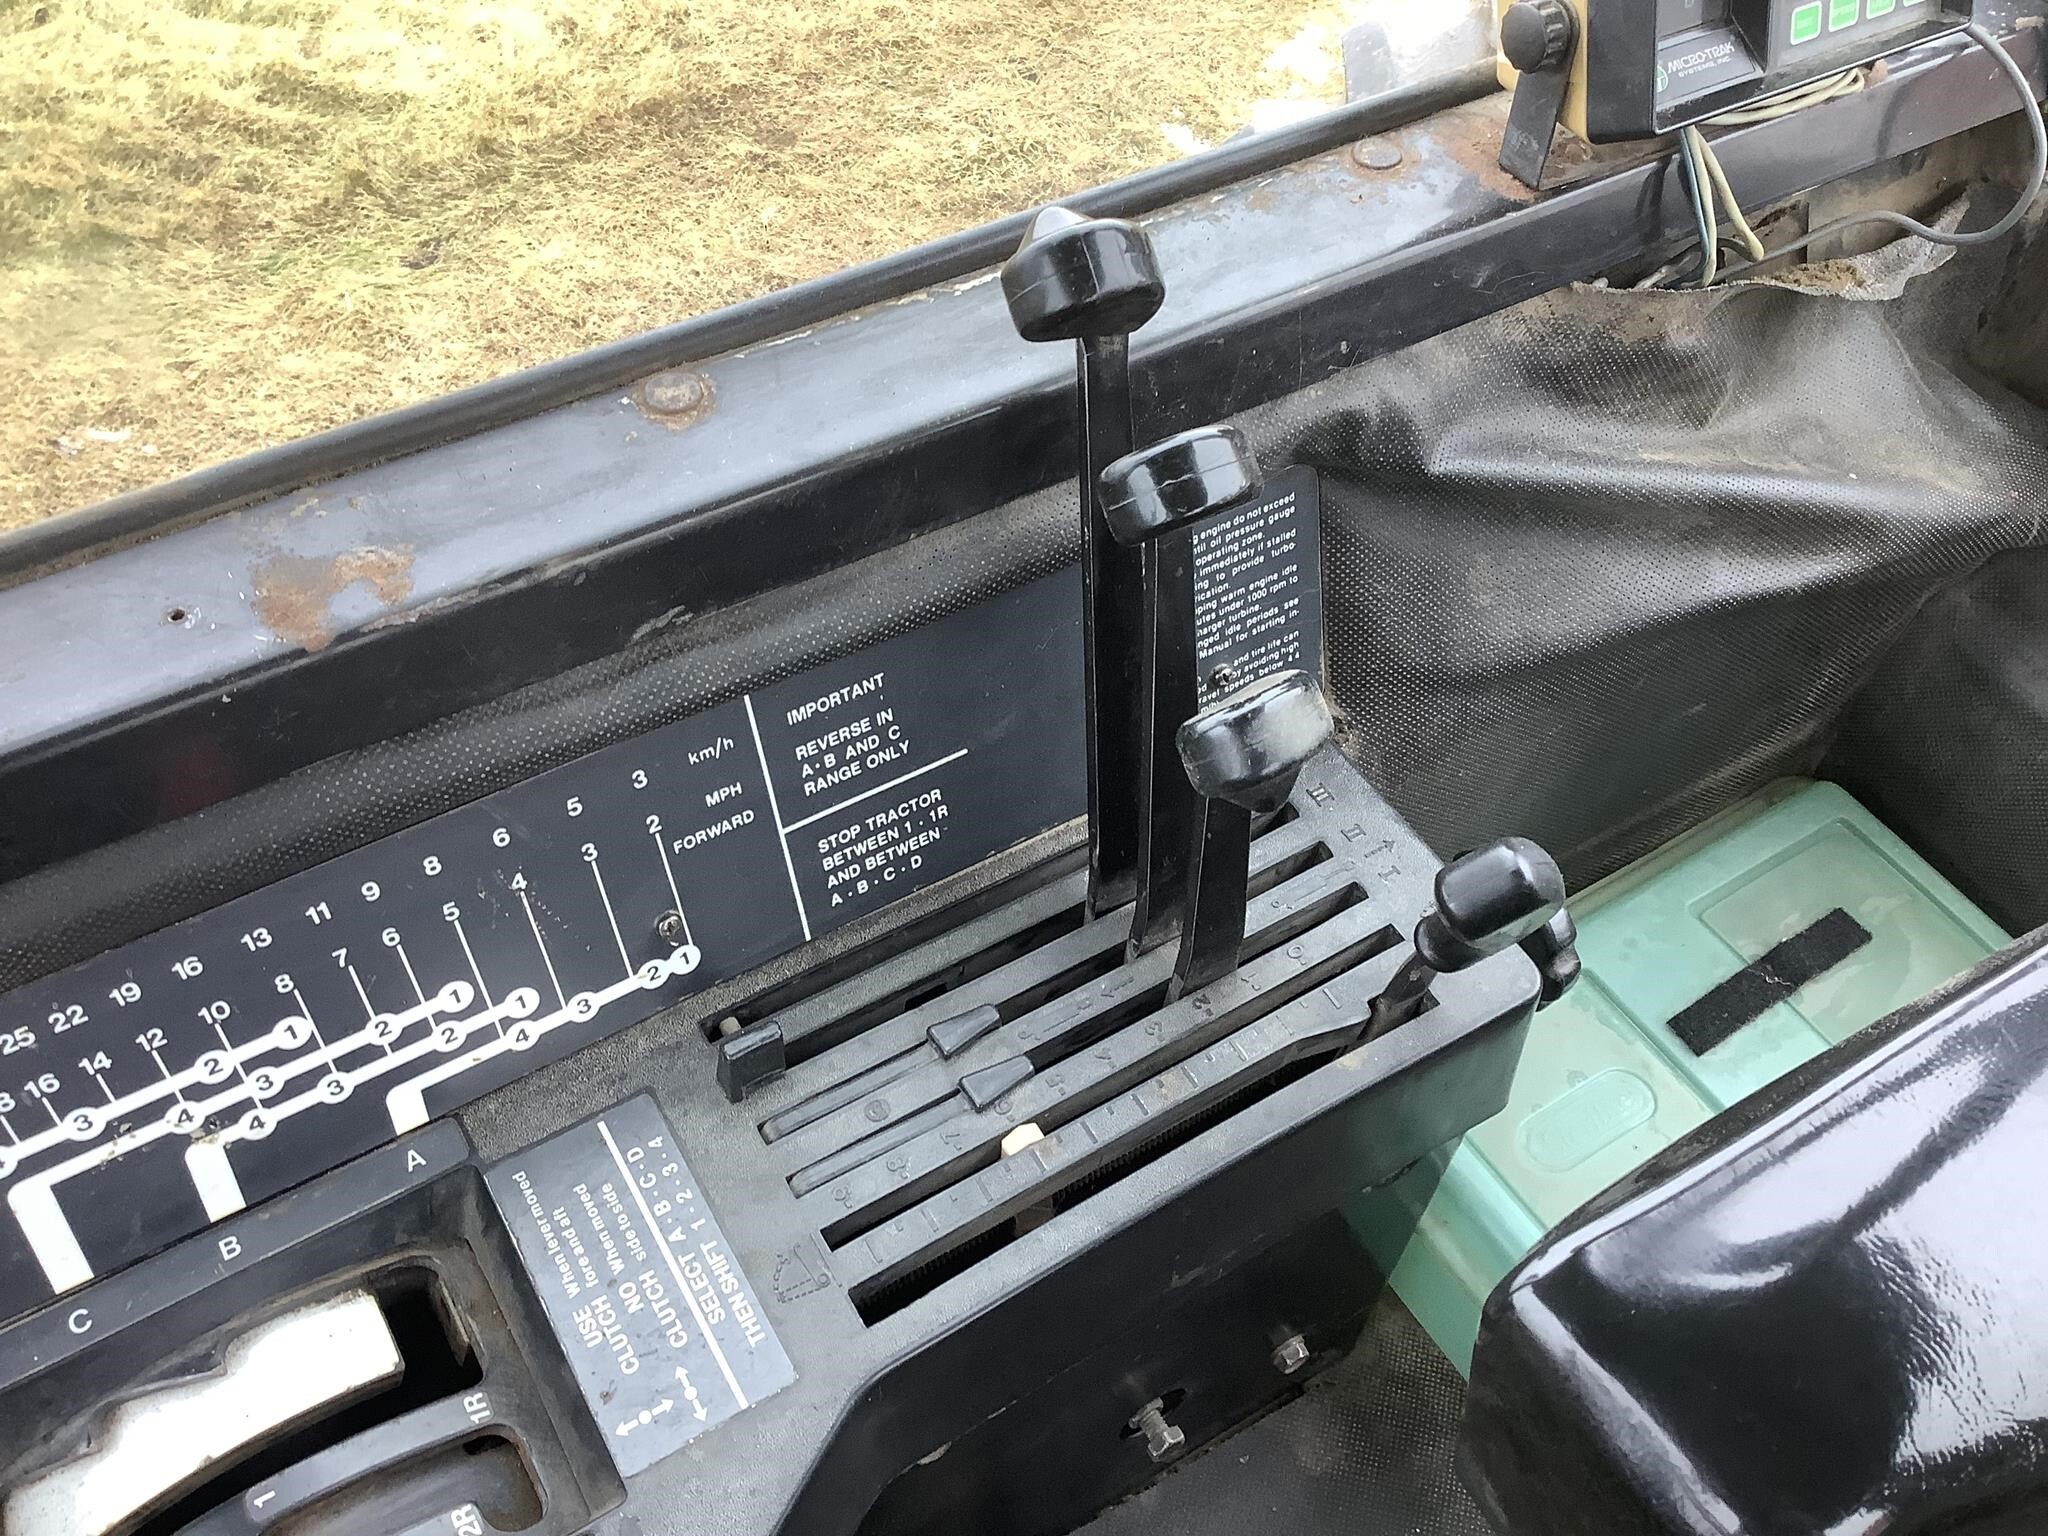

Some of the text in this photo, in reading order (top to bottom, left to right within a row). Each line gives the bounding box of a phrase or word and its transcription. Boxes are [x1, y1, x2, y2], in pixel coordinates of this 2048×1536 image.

[1668, 41, 1735, 74] MICRO-TRAK
[1200, 521, 1231, 540] engine
[1233, 515, 1245, 526] do
[1247, 506, 1261, 520] not
[1263, 491, 1295, 513] exceed
[1210, 535, 1222, 548] oil
[1225, 519, 1265, 543] pressure
[1268, 505, 1295, 525] gauge
[1195, 531, 1265, 566] operating zone.
[1200, 527, 1296, 577] immediately if stalled
[1216, 572, 1226, 582] to
[1232, 555, 1265, 577] provide
[1271, 541, 1297, 558] turbo-
[1219, 599, 1245, 616] under
[1247, 588, 1267, 603] 1000
[1270, 580, 1287, 594] rpm
[1289, 575, 1298, 584] to
[1221, 587, 1246, 603] warm
[1249, 572, 1278, 591] engine
[1282, 564, 1298, 576] idle
[1199, 638, 1232, 659] Manual
[1236, 632, 1248, 643] for
[1252, 615, 1285, 635] starting
[1225, 624, 1241, 636] idle
[1247, 607, 1279, 628] periods
[1284, 598, 1299, 609] see
[1229, 604, 1262, 623] turbine.
[1234, 630, 1299, 666] and tire life can
[1244, 651, 1279, 672] avoiding
[1281, 642, 1299, 654] high
[786, 672, 885, 725] IMPORTANT
[1224, 674, 1254, 692] speeds
[1259, 660, 1283, 676] below
[795, 708, 894, 761] REVERSE IN
[845, 734, 880, 760] AND
[888, 725, 901, 740] C
[804, 739, 910, 797] RANGE ONLY
[673, 810, 754, 854] FORWARD
[818, 788, 942, 854] STOP TRACTOR
[822, 804, 949, 872] BETWEEN 1 1R
[827, 827, 941, 889] AND BETWEEN
[0, 737, 734, 1055] 25 22 19 16 13 11 9 8 6 5 3 km/h
[23, 1073, 60, 1098] 16
[78, 1051, 112, 1076] 14
[135, 1028, 168, 1051] 12
[198, 1000, 231, 1024] 10
[274, 973, 294, 993] 8
[331, 948, 347, 968] 7
[381, 927, 400, 947] 6
[442, 901, 460, 921] 5
[511, 872, 528, 890] 4
[582, 843, 598, 861] 3
[646, 815, 662, 834] 2
[705, 782, 742, 807] MPH
[515, 953, 690, 1044] 4 3 2 1
[73, 1025, 298, 1131] 3 2 1
[177, 989, 463, 1125] 4 3 2 1
[249, 995, 528, 1132] 4 3 2 1
[406, 1148, 427, 1172] A
[512, 1170, 581, 1299] When lever moved
[553, 1206, 599, 1288] fore and aft
[573, 1183, 626, 1276] When moved
[602, 1183, 647, 1262] side to side
[218, 1236, 242, 1262] B
[700, 1240, 739, 1294] SHIFT
[618, 1281, 645, 1315] NO
[638, 1269, 689, 1349] CLUTCH
[677, 1252, 726, 1325] SELECT
[68, 1308, 93, 1335] C
[572, 1304, 603, 1349] USE
[591, 1294, 640, 1376] CLUTCH
[727, 1292, 766, 1348] THEN
[463, 1392, 491, 1424] 1R
[254, 1490, 276, 1508] 1
